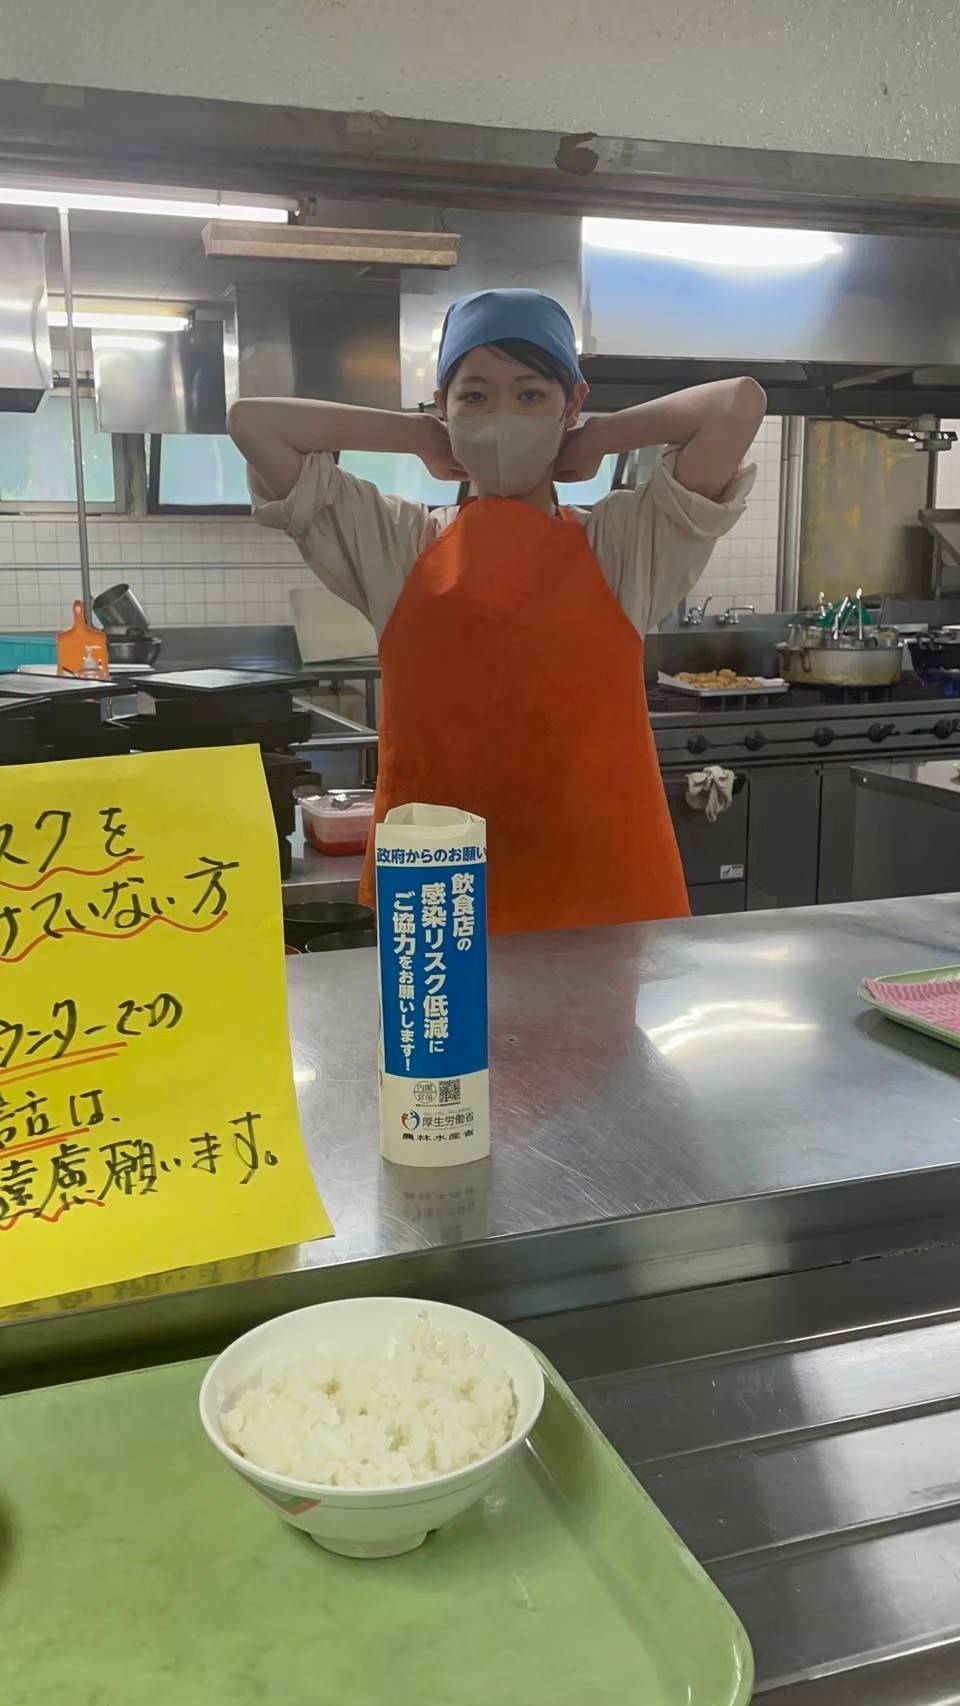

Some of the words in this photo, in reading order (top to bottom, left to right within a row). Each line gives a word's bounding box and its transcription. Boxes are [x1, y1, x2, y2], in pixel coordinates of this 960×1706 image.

[377, 846, 487, 864] 政府からのお願い
[451, 873, 475, 951] 飲食店の
[392, 891, 416, 1071] ご協力をお願いします！
[421, 882, 449, 1053] 感染リスク低減に
